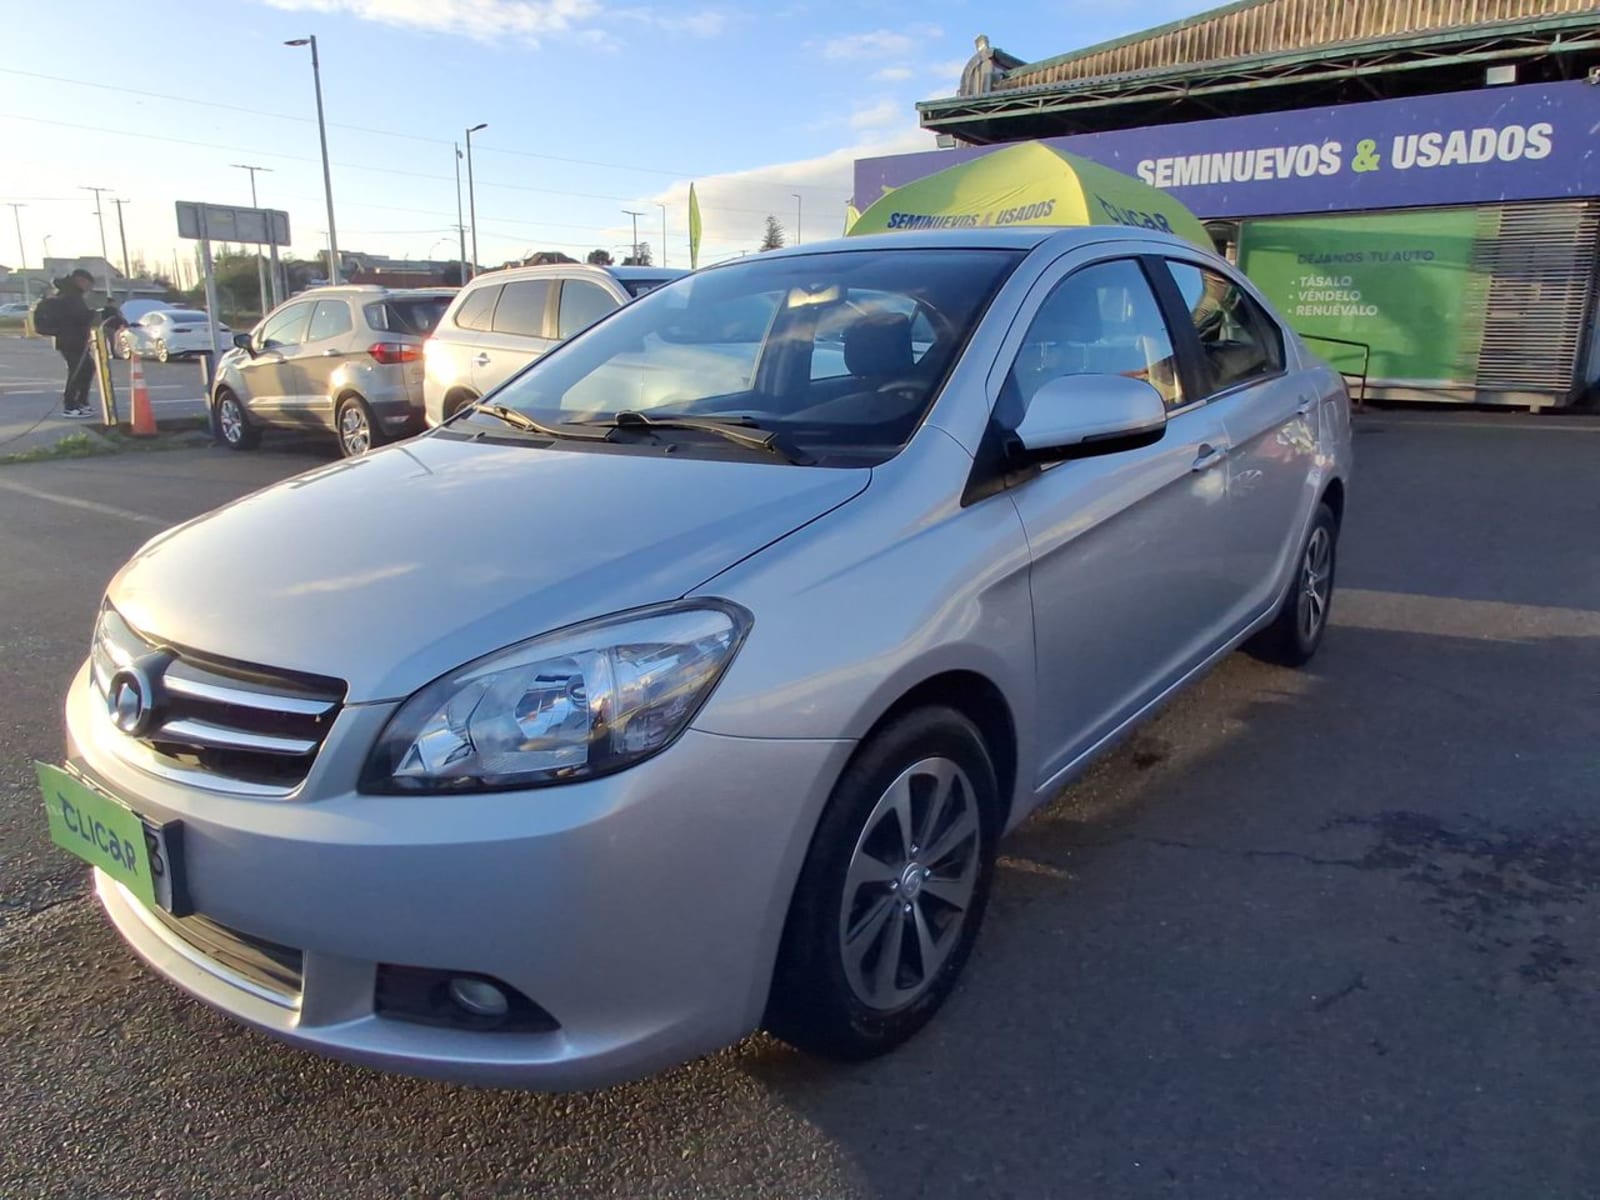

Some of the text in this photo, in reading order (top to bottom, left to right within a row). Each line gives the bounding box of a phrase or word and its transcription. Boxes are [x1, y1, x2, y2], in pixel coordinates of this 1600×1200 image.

[1137, 122, 1553, 188] SEMINUEVOS & USADOS
[887, 211, 980, 229] SEMINUEVOS
[994, 199, 1056, 225] USADOS
[1369, 250, 1389, 264] TU
[1392, 249, 1435, 263] AUTO
[1299, 274, 1352, 287] TÁSALO
[1298, 288, 1361, 301] VÉNDELO
[1295, 302, 1378, 317] RENUÉVALO
